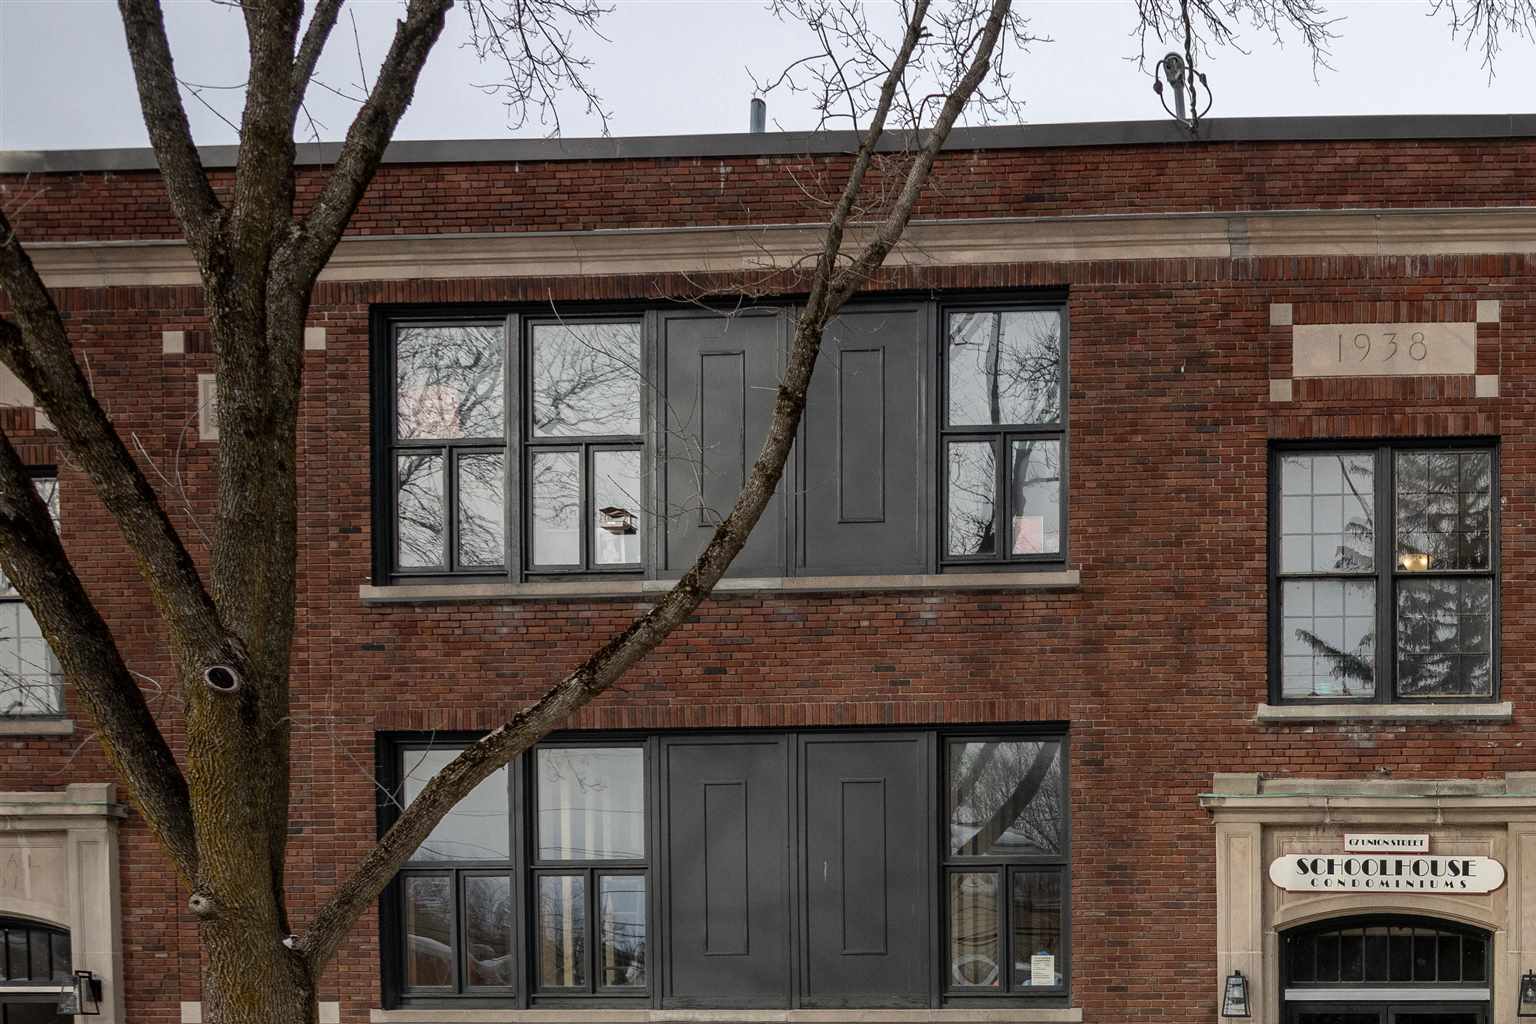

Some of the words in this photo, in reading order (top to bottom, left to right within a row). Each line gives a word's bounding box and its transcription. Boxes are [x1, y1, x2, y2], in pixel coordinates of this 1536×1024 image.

[1338, 331, 1427, 363] 1938
[1361, 838, 1389, 846] UNION
[1390, 838, 1424, 846] STREET
[1296, 857, 1477, 877] SCHOOLHOUSE
[1311, 878, 1467, 889] CONDOMINIUMS
